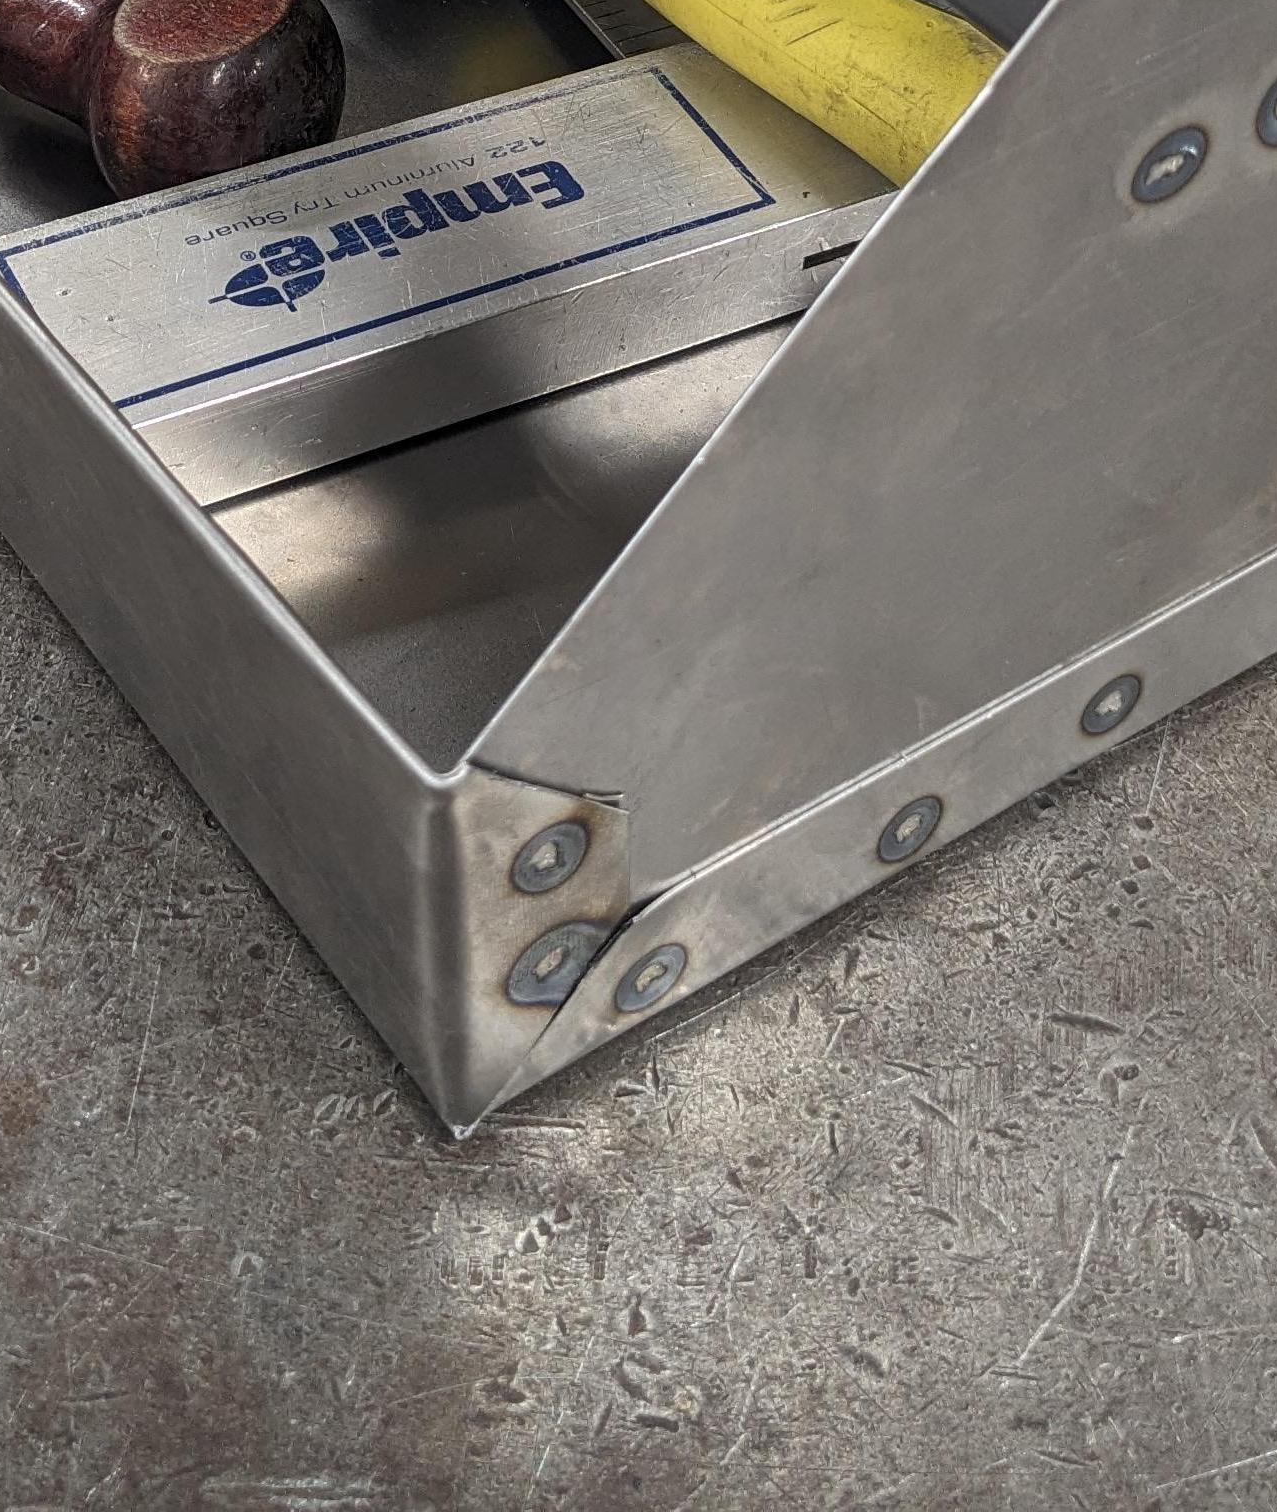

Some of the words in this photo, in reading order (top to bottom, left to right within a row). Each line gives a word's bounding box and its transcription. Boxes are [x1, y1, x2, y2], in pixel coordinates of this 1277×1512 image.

[343, 153, 476, 201] Aluminum
[294, 189, 339, 214] Try
[184, 205, 289, 249] Square
